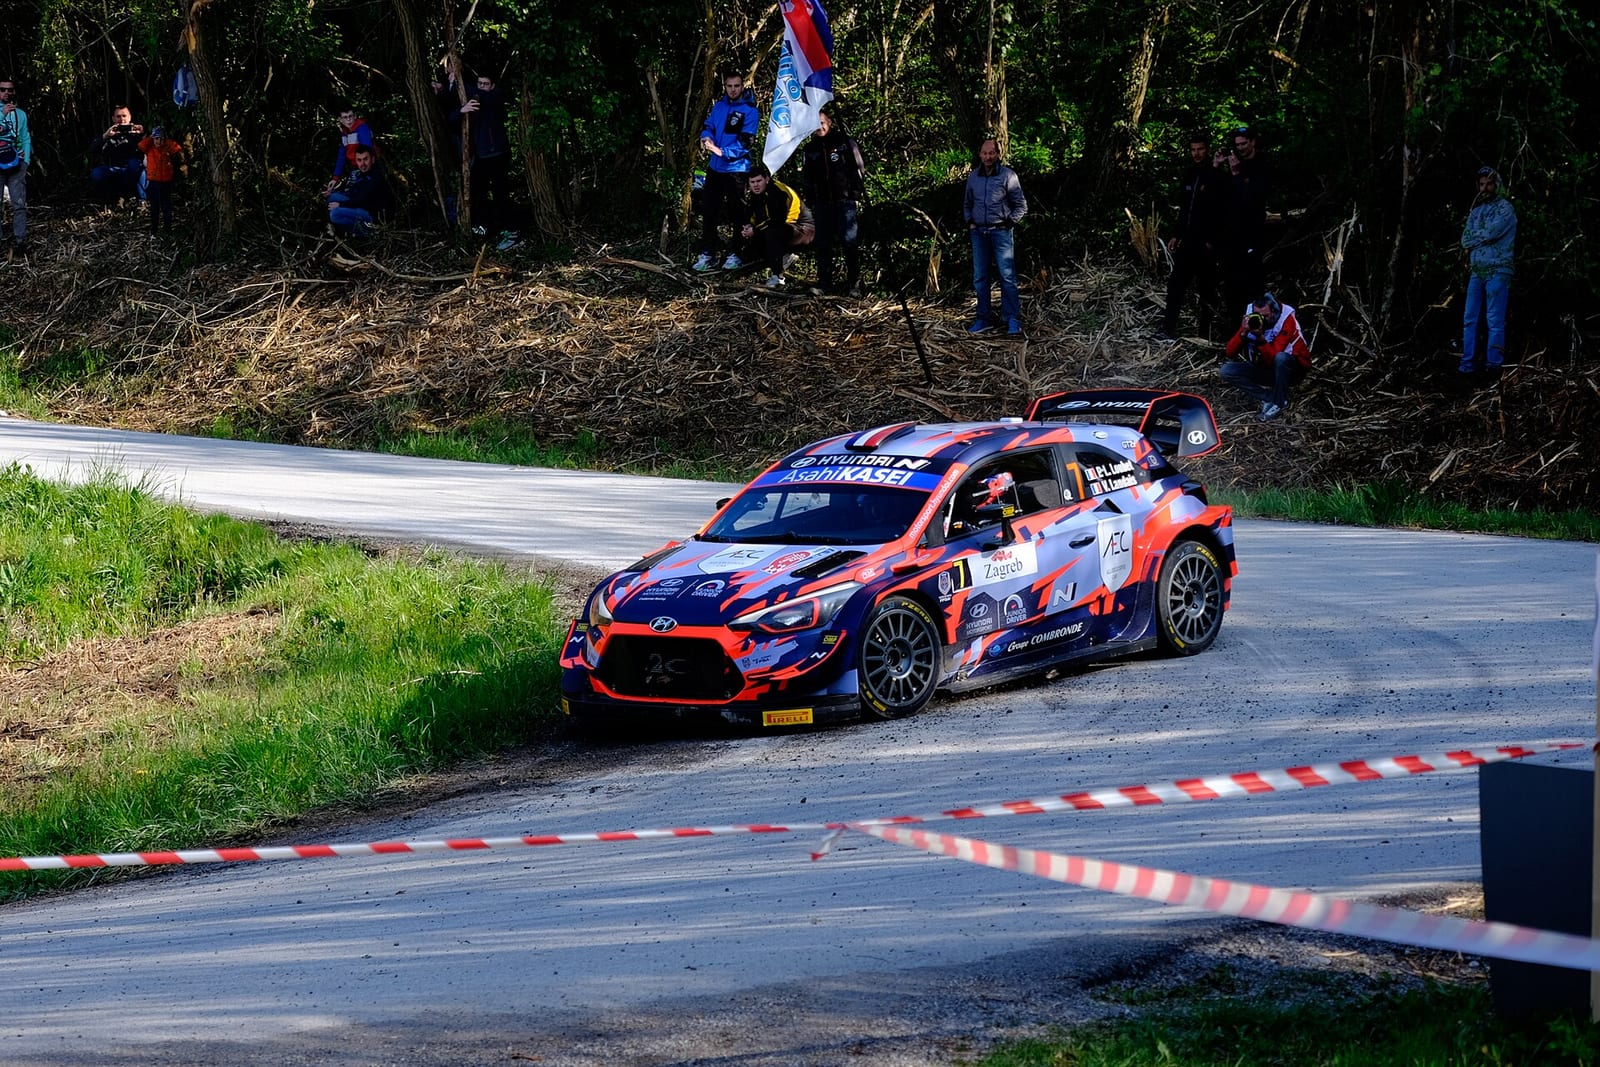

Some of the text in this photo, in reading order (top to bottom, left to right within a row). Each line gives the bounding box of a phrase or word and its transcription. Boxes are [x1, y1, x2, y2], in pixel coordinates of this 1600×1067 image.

[817, 455, 895, 468] HYUNDAI
[778, 466, 914, 486] AsahiKASEI
[984, 557, 1024, 580] Zagreb
[966, 617, 993, 629] HYUNDAI
[1006, 614, 1027, 624] DRIVER
[1030, 622, 1084, 645] COMBRONDE
[767, 711, 809, 724] PIRELLI
